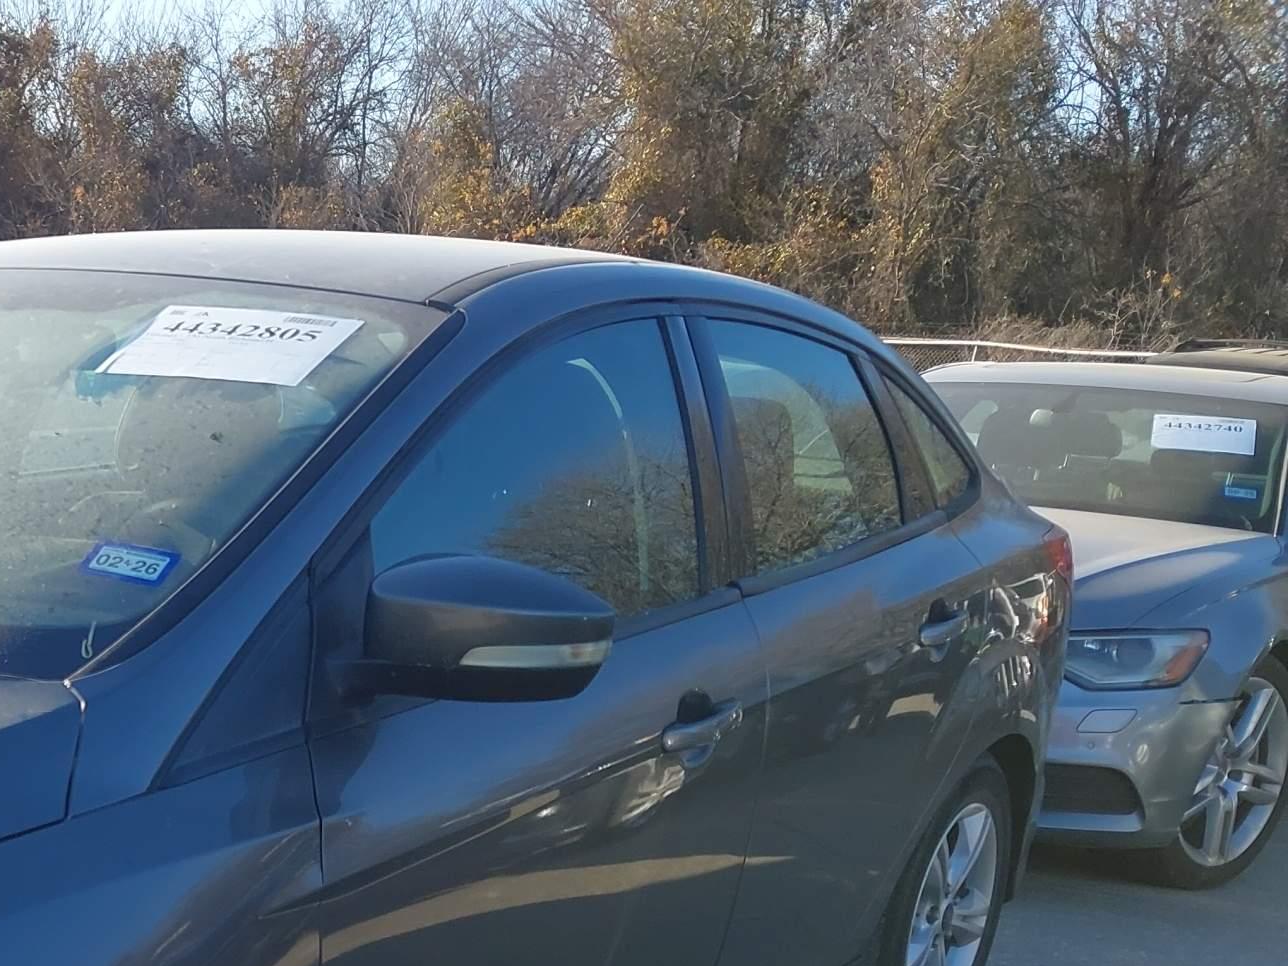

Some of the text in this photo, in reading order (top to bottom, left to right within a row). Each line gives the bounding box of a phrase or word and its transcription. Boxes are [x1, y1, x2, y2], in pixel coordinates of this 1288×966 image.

[163, 320, 323, 342] 44342805
[1164, 422, 1243, 432] 44342740
[96, 554, 124, 568] 02
[131, 560, 160, 575] 26
